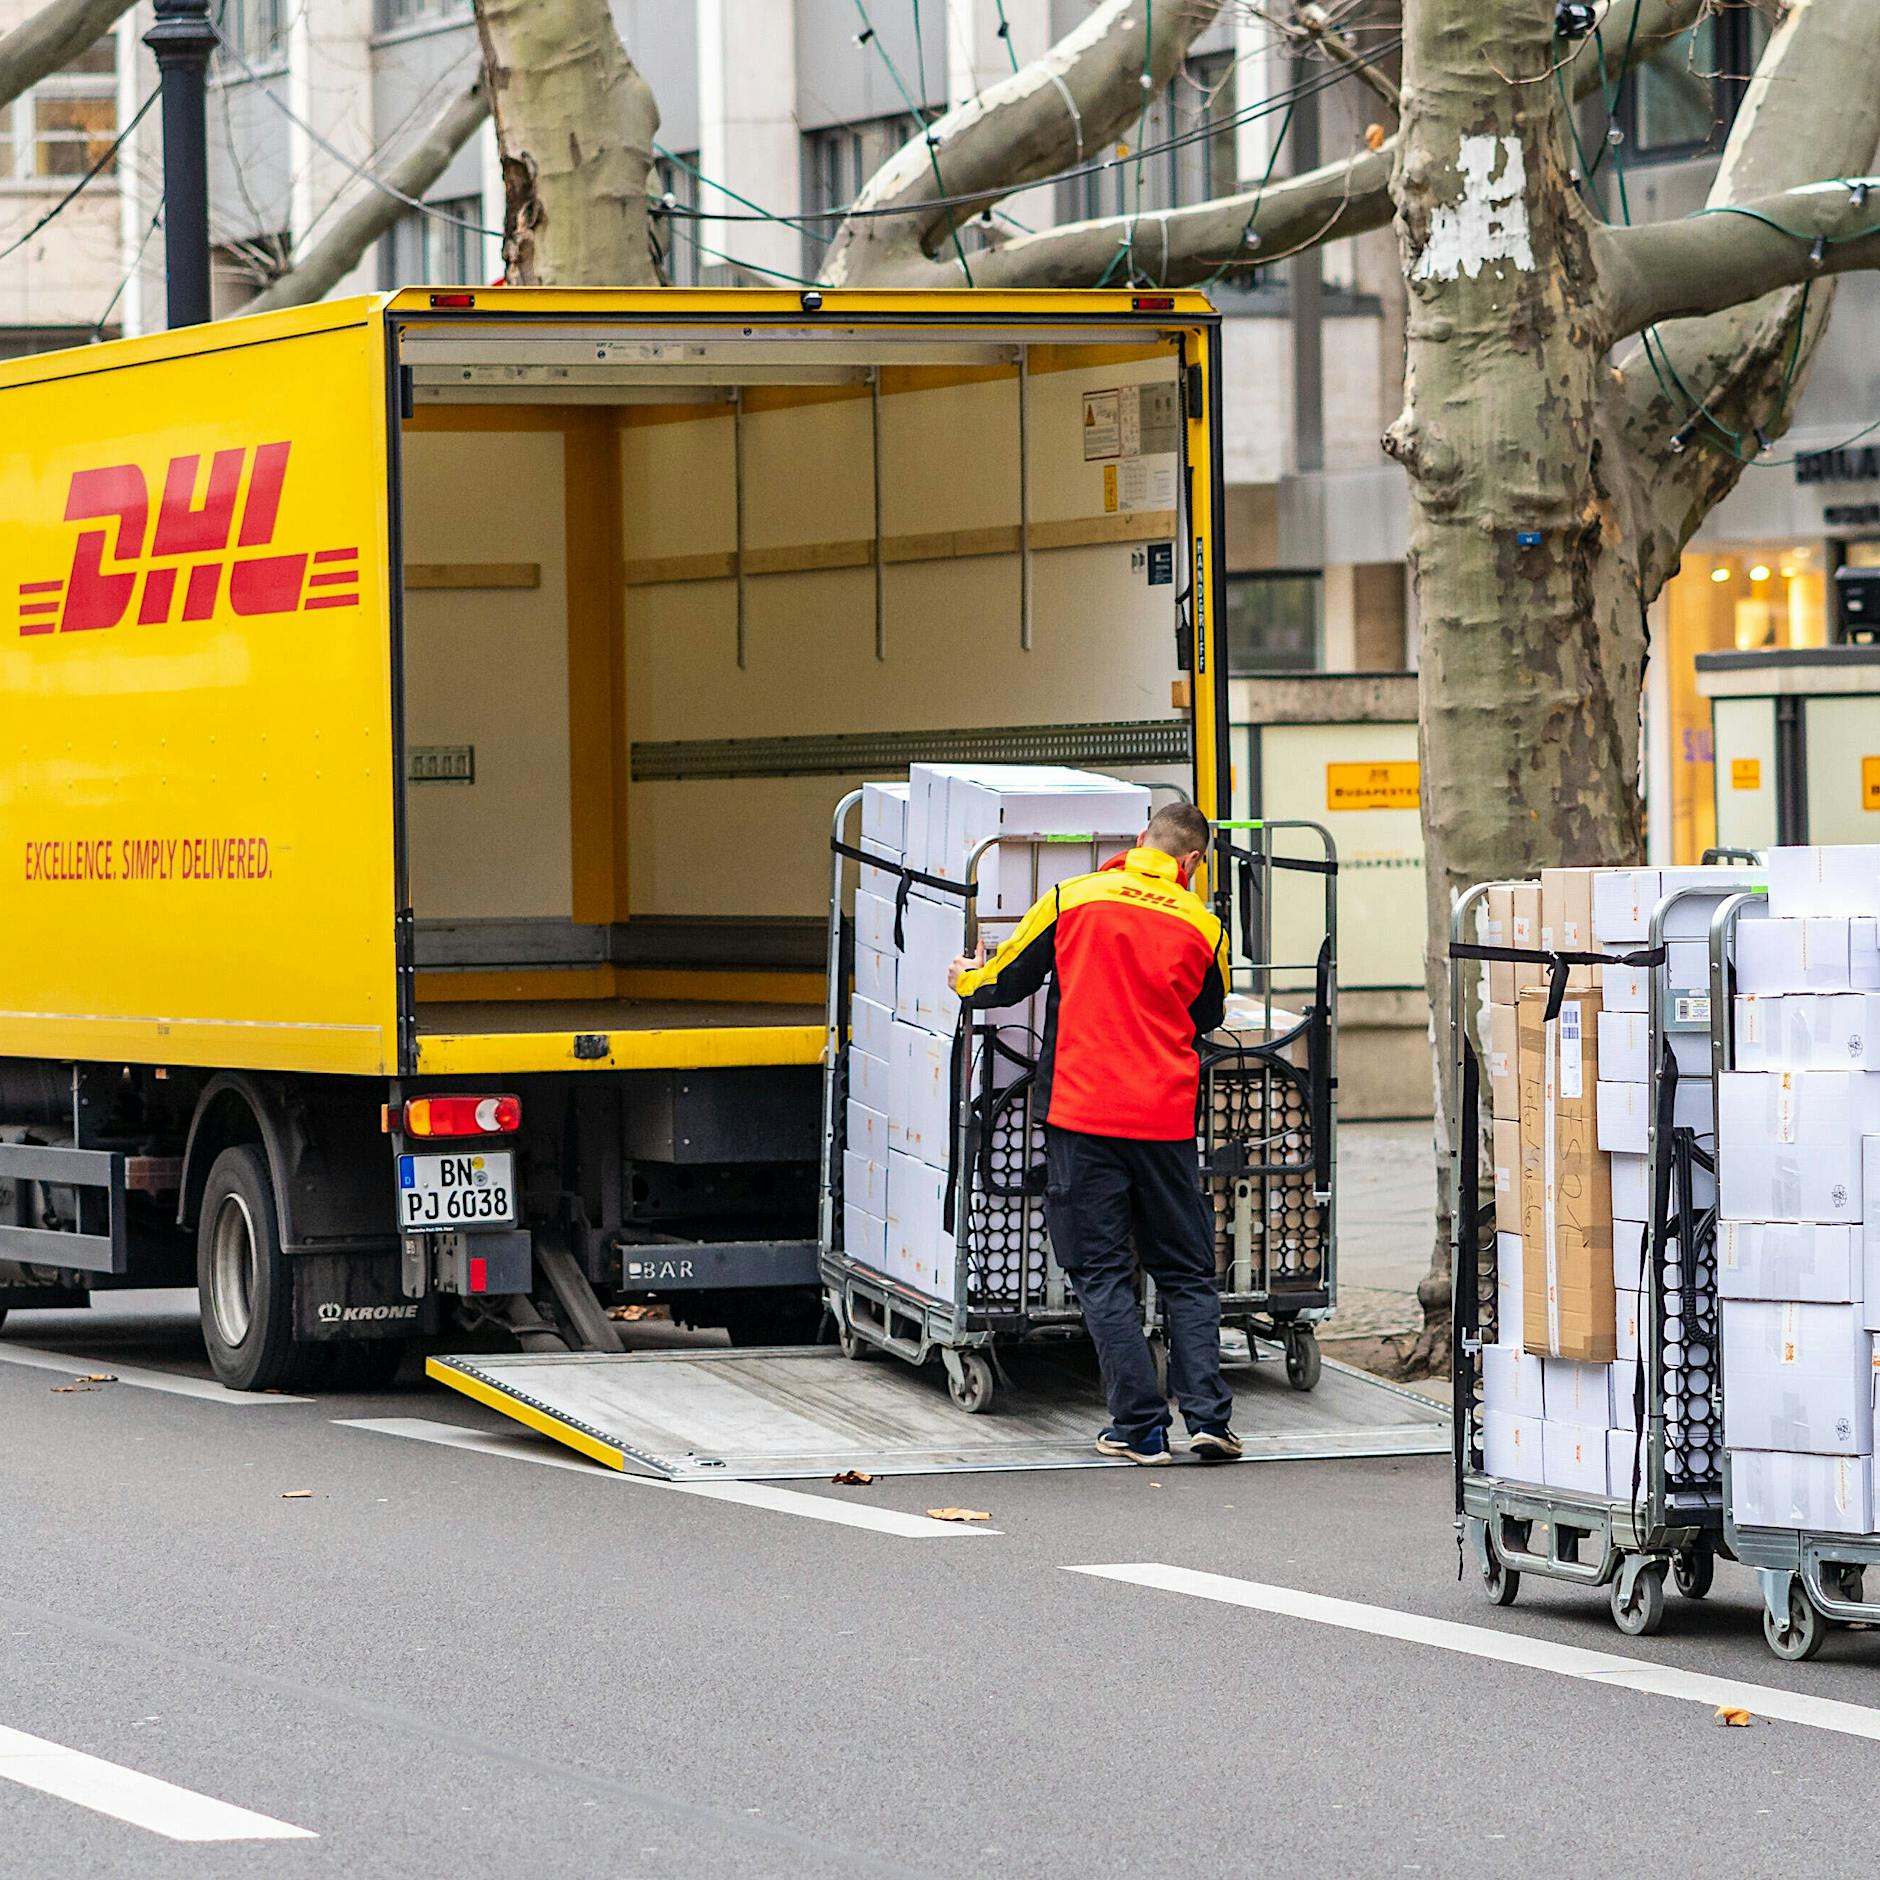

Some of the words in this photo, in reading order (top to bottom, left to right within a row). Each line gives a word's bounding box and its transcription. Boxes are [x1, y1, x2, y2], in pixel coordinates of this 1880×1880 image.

[60, 440, 309, 633] DHL
[1197, 538, 1205, 672] HANDGRIFF
[25, 840, 117, 881] EXCELLENCE.
[122, 839, 178, 880] SIMPLY
[181, 837, 273, 880] DELIVERED.
[1119, 886, 1180, 910] DHL
[404, 1176, 412, 1185] D
[440, 1157, 473, 1188] BN
[407, 1191, 439, 1221] PJ
[447, 1187, 508, 1219] 6038
[343, 1304, 419, 1321] KRONE
